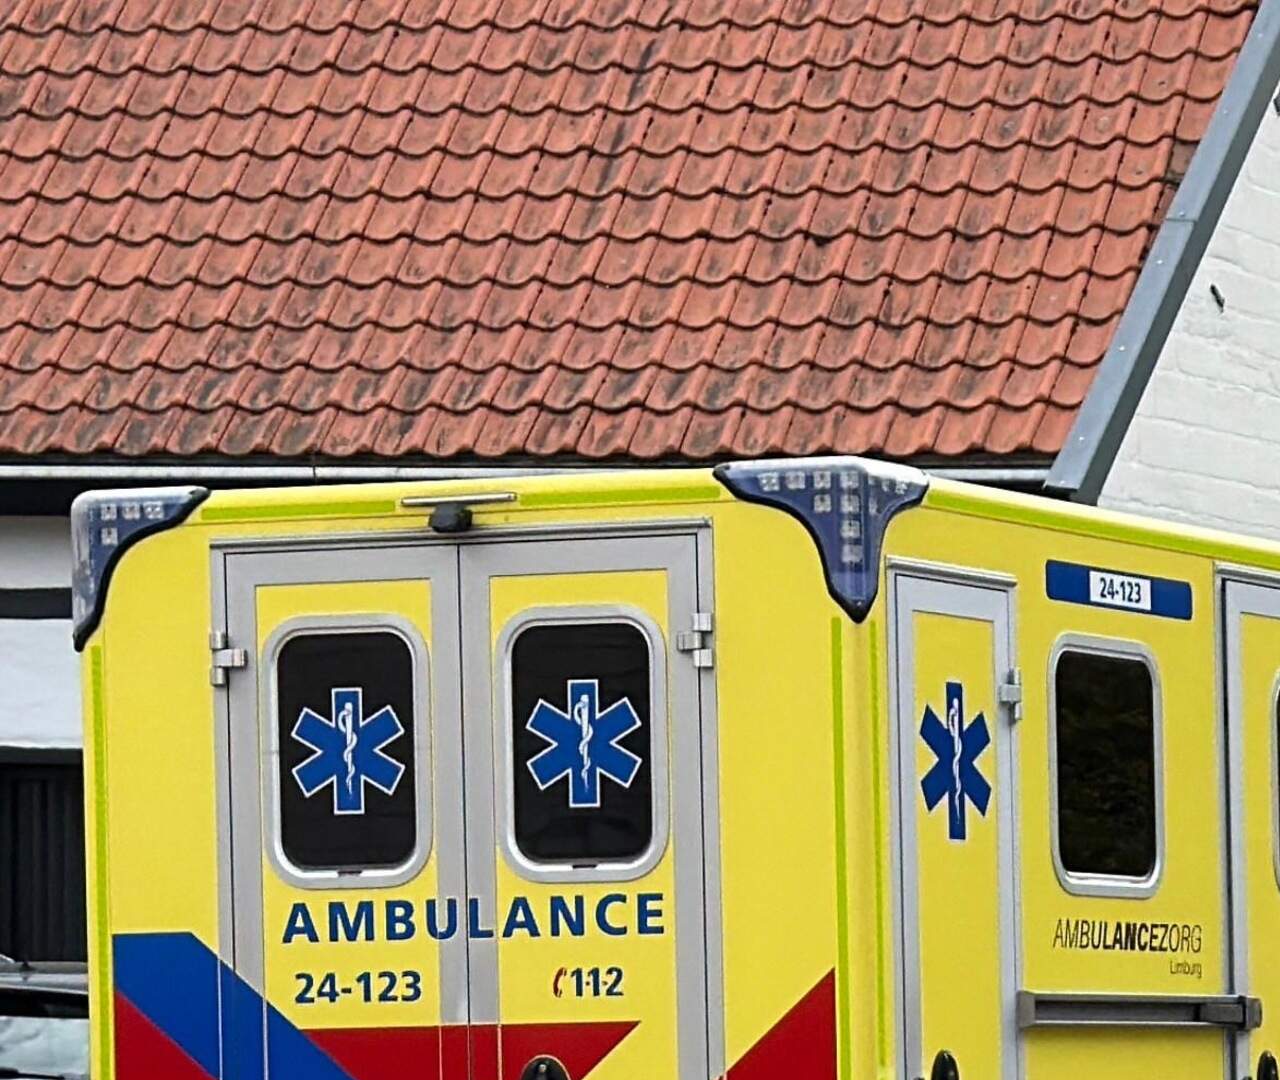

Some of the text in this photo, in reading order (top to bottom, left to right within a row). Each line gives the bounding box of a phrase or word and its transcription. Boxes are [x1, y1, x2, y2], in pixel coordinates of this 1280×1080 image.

[1100, 577, 1141, 603] 24-123
[281, 892, 665, 943] AMBULANCE
[1052, 917, 1202, 953] AMBULANCEZORG
[294, 970, 422, 1004] 24-123
